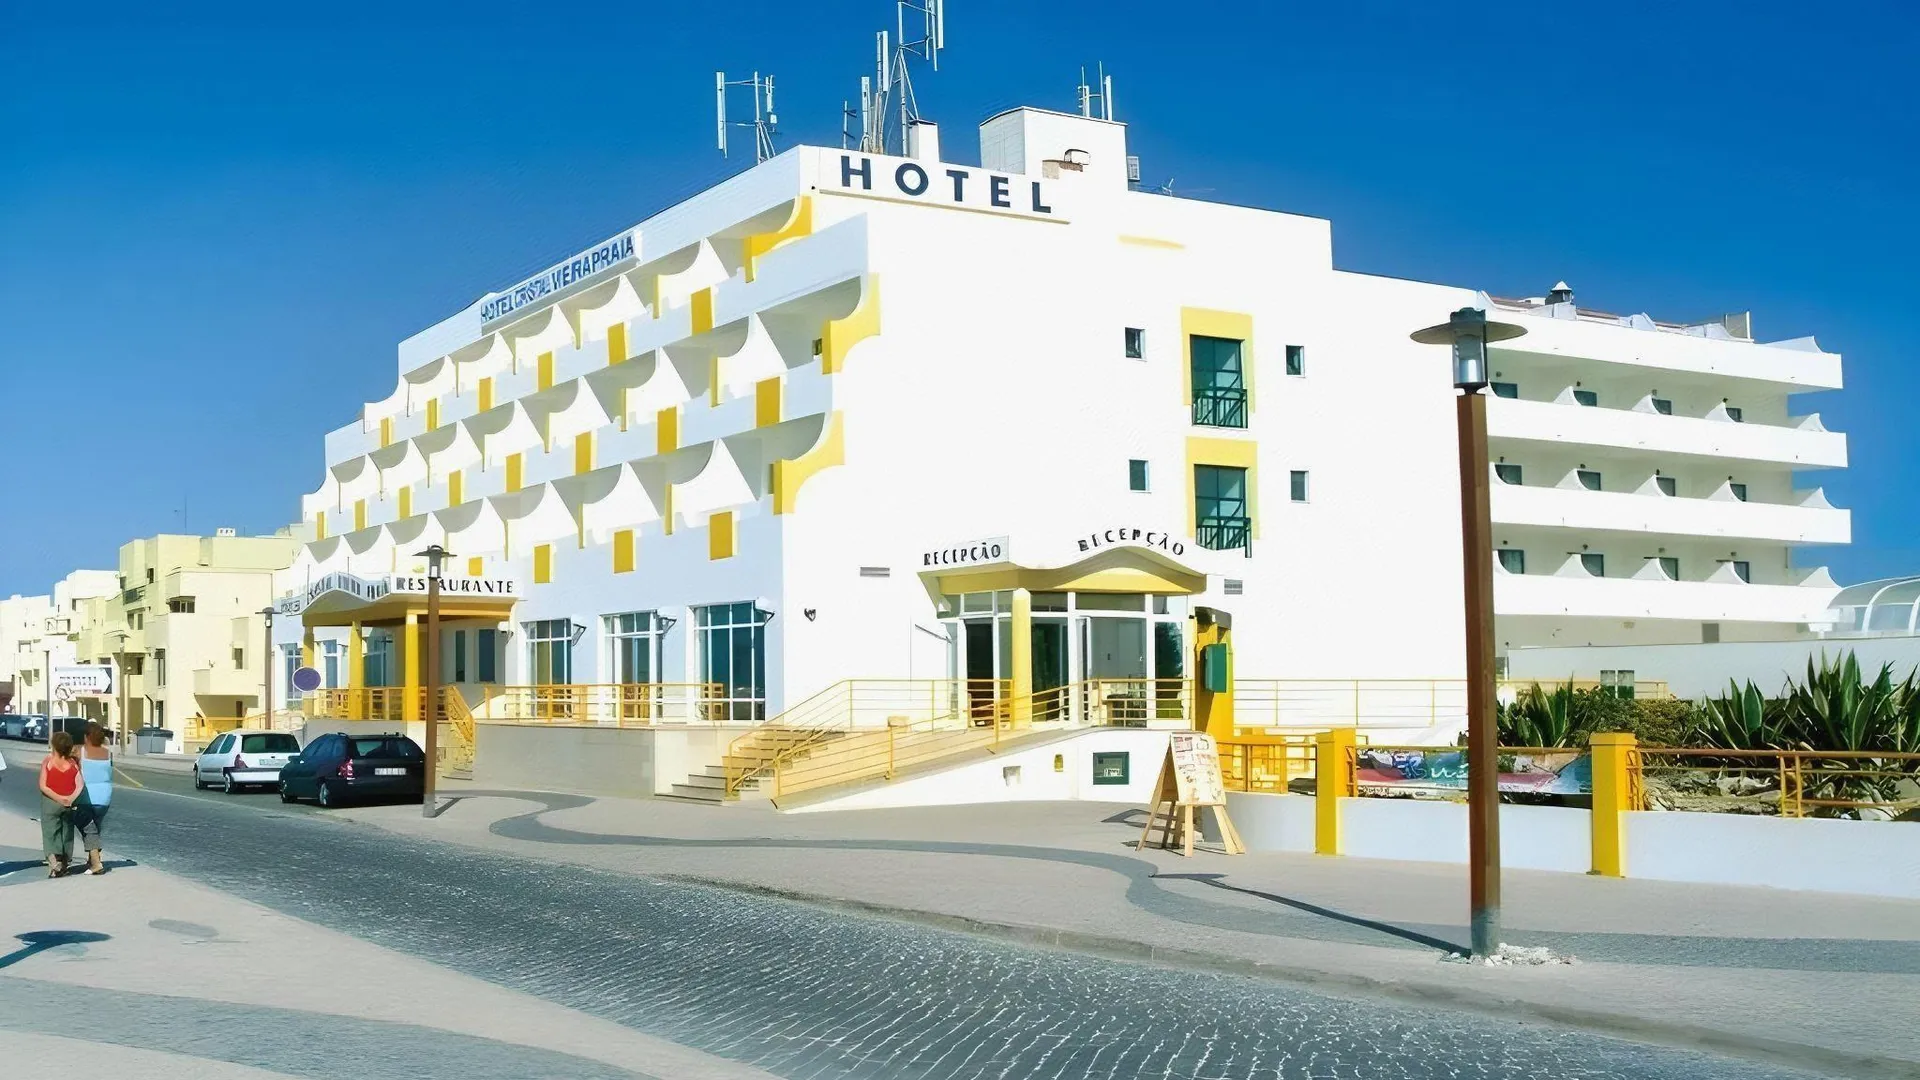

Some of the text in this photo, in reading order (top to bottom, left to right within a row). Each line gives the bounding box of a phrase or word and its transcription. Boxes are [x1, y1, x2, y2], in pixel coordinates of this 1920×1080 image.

[840, 155, 1052, 214] HOTEL
[923, 541, 1001, 566] RECEPÇÃO
[1077, 528, 1184, 556] RECEPÇÃO
[396, 577, 514, 594] RESAURANTE
